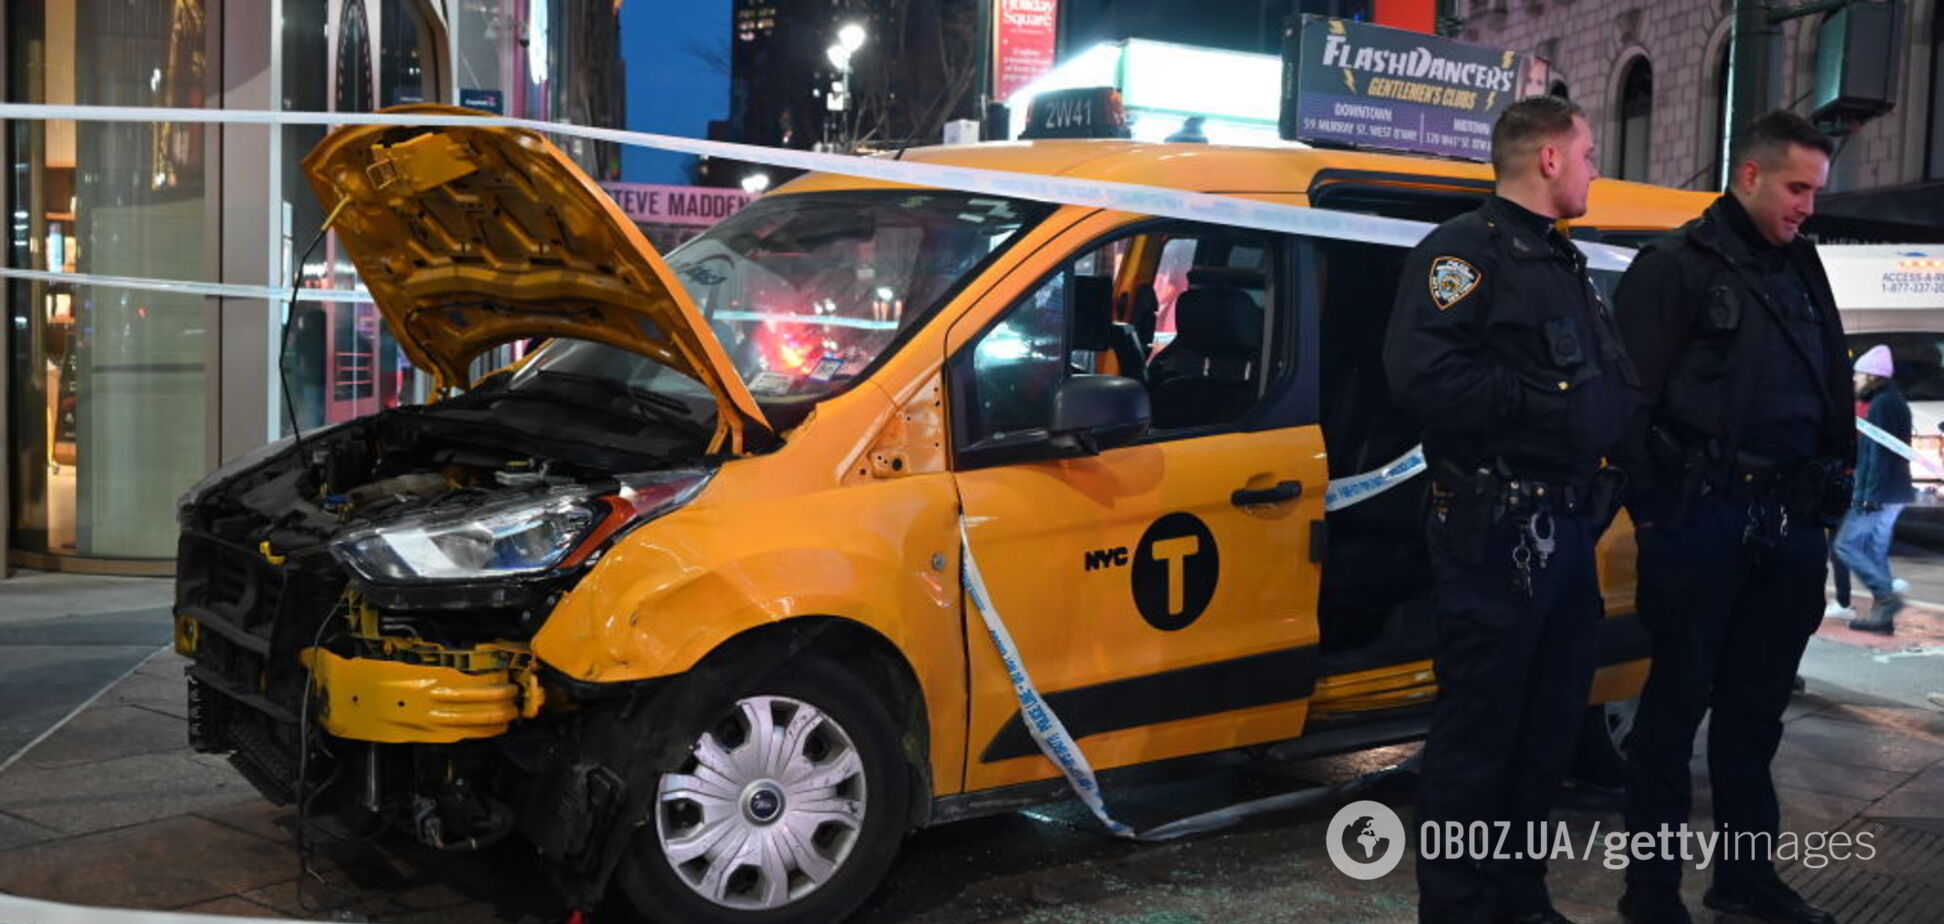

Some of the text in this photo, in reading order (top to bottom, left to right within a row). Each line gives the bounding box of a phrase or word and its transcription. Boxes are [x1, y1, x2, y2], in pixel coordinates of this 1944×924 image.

[1003, 11, 1053, 29] Square
[1367, 77, 1477, 110] GENTLEMEN'S CLUBS
[1045, 98, 1093, 129] 2W41
[1334, 102, 1393, 122] DOWNTOWN
[1318, 119, 1354, 135] MURRAY
[1370, 126, 1392, 138] WEST
[610, 189, 660, 214] TEVE
[1084, 534, 1199, 616] NYC T
